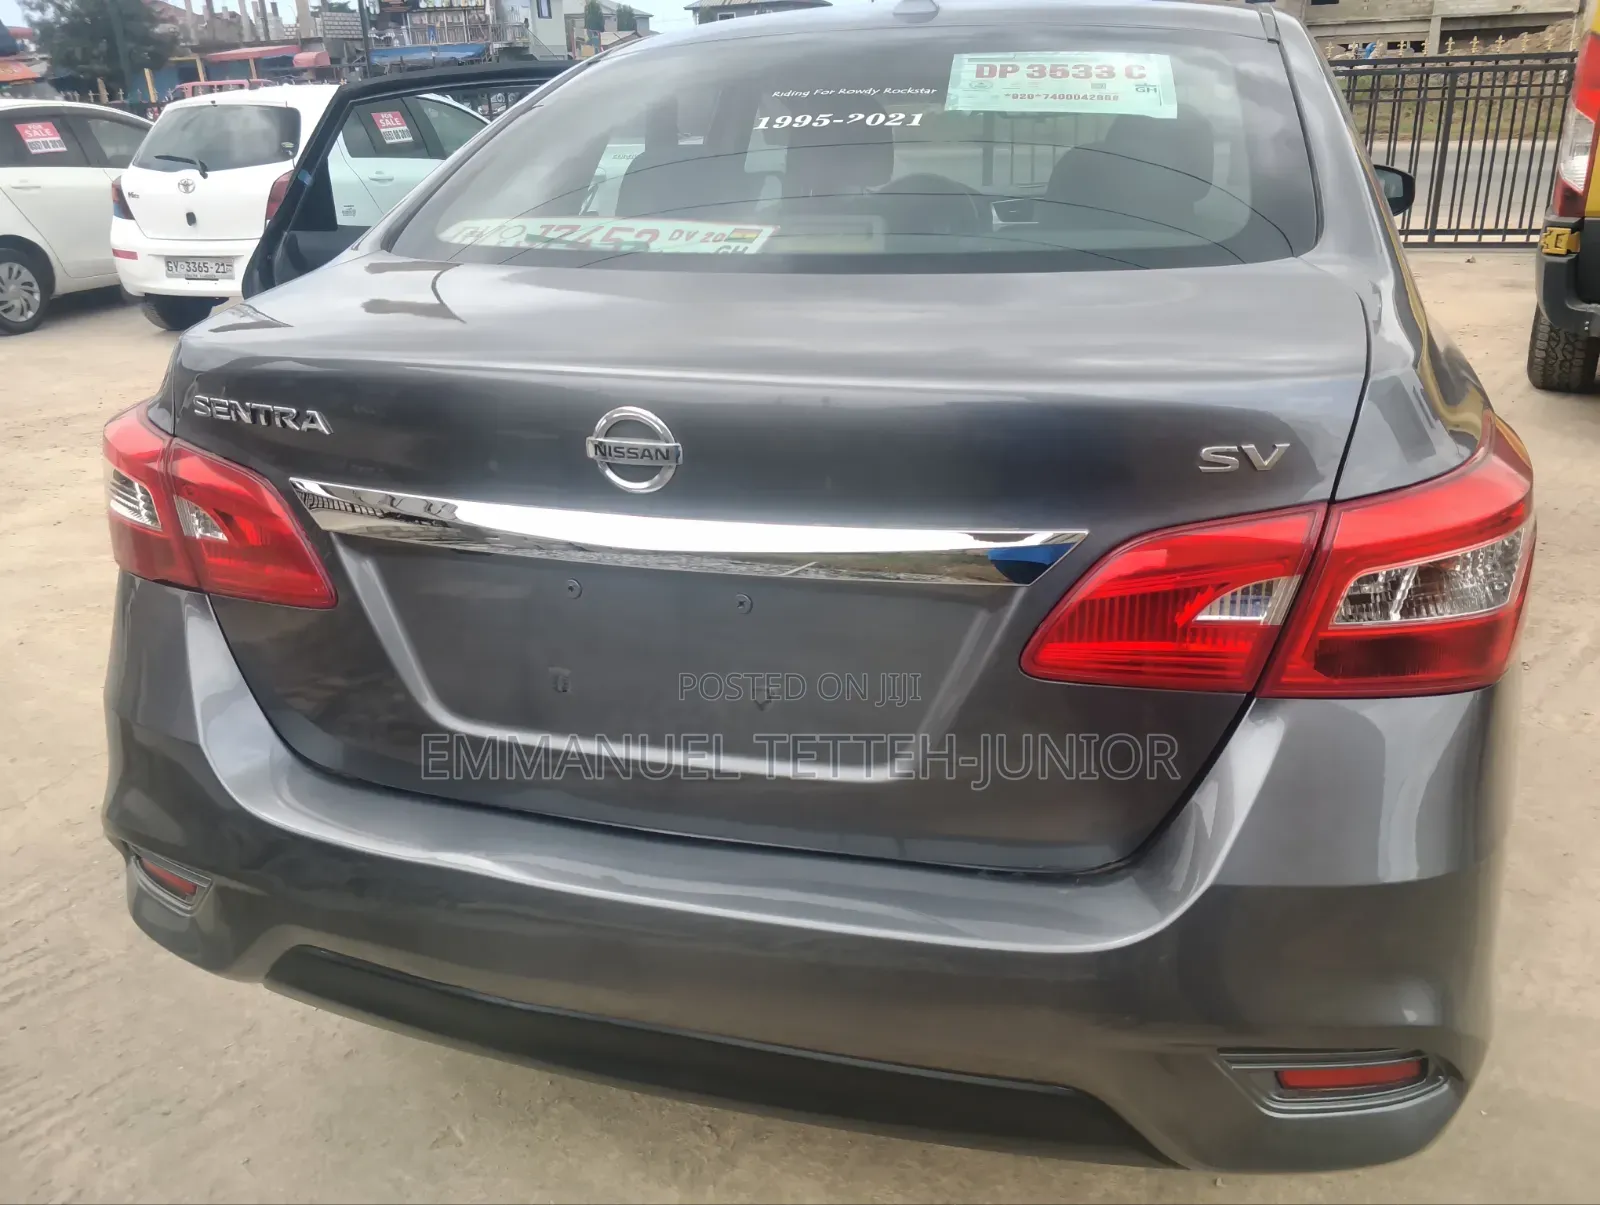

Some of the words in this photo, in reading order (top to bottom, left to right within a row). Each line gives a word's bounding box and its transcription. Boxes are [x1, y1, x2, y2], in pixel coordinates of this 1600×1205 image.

[975, 63, 1020, 79] DP
[1026, 63, 1116, 80] 3533
[1124, 64, 1147, 80] C
[771, 89, 810, 98] Riding
[813, 88, 836, 96] For
[838, 87, 881, 96] Rowdy
[883, 87, 937, 95] Rockstar
[379, 117, 402, 127] SALE
[753, 112, 924, 130] 1995-2021
[24, 128, 53, 138] SALE
[166, 260, 179, 272] GY
[193, 395, 334, 435] SENTRA
[594, 444, 670, 461] NISSAN
[1199, 443, 1291, 473] SV
